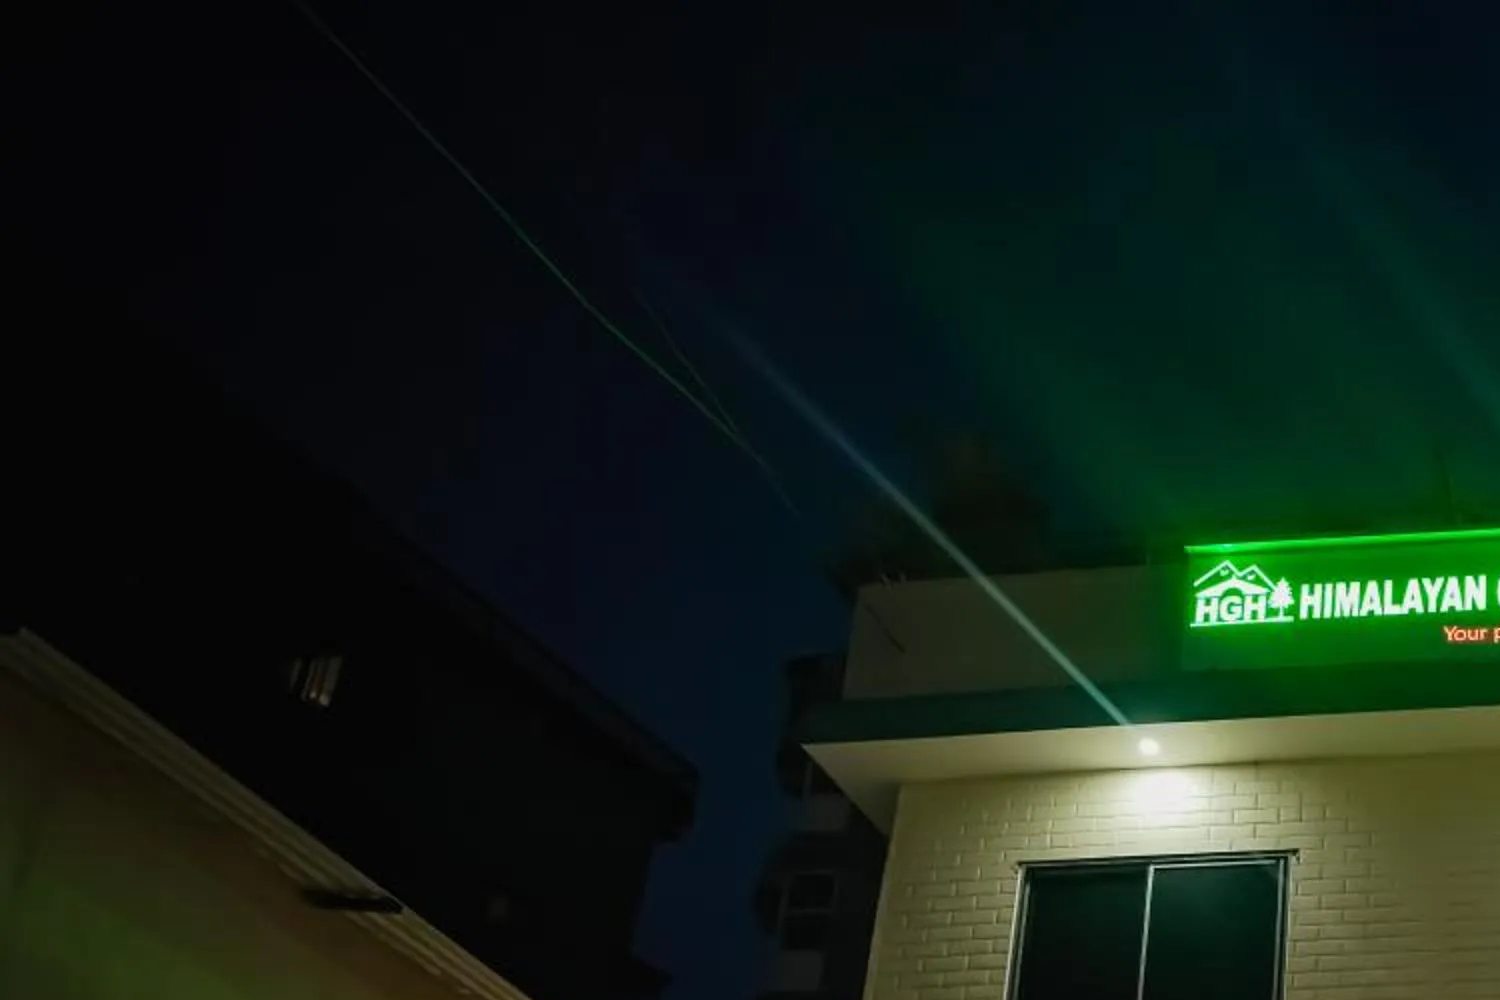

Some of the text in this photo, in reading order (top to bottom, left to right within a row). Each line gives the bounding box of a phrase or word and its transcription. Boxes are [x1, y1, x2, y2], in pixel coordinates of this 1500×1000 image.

[1195, 594, 1267, 625] HGH
[1300, 574, 1487, 619] HIMALAYAN
[1443, 625, 1489, 642] Your
